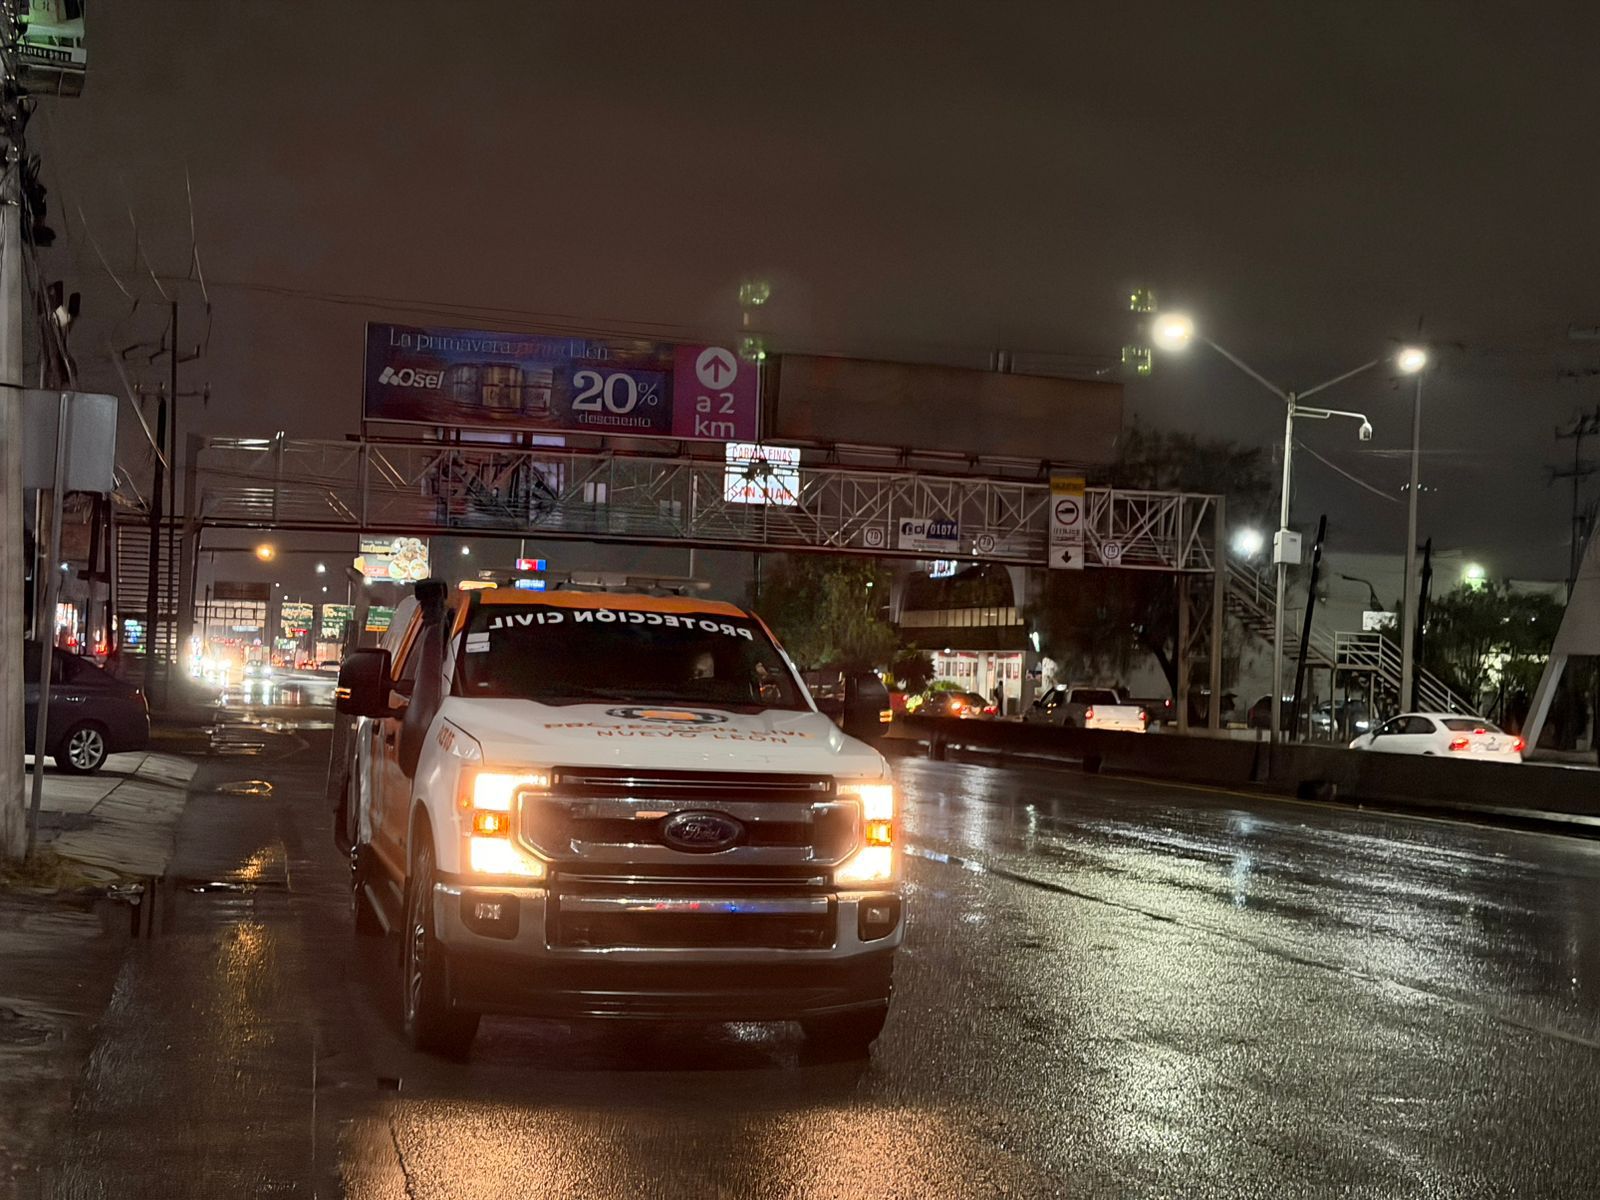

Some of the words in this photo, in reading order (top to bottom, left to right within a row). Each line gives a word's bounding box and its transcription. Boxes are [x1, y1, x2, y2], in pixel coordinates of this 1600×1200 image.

[399, 368, 445, 389] Osel
[695, 395, 711, 412] a
[718, 392, 735, 414] 2
[694, 414, 735, 437] km
